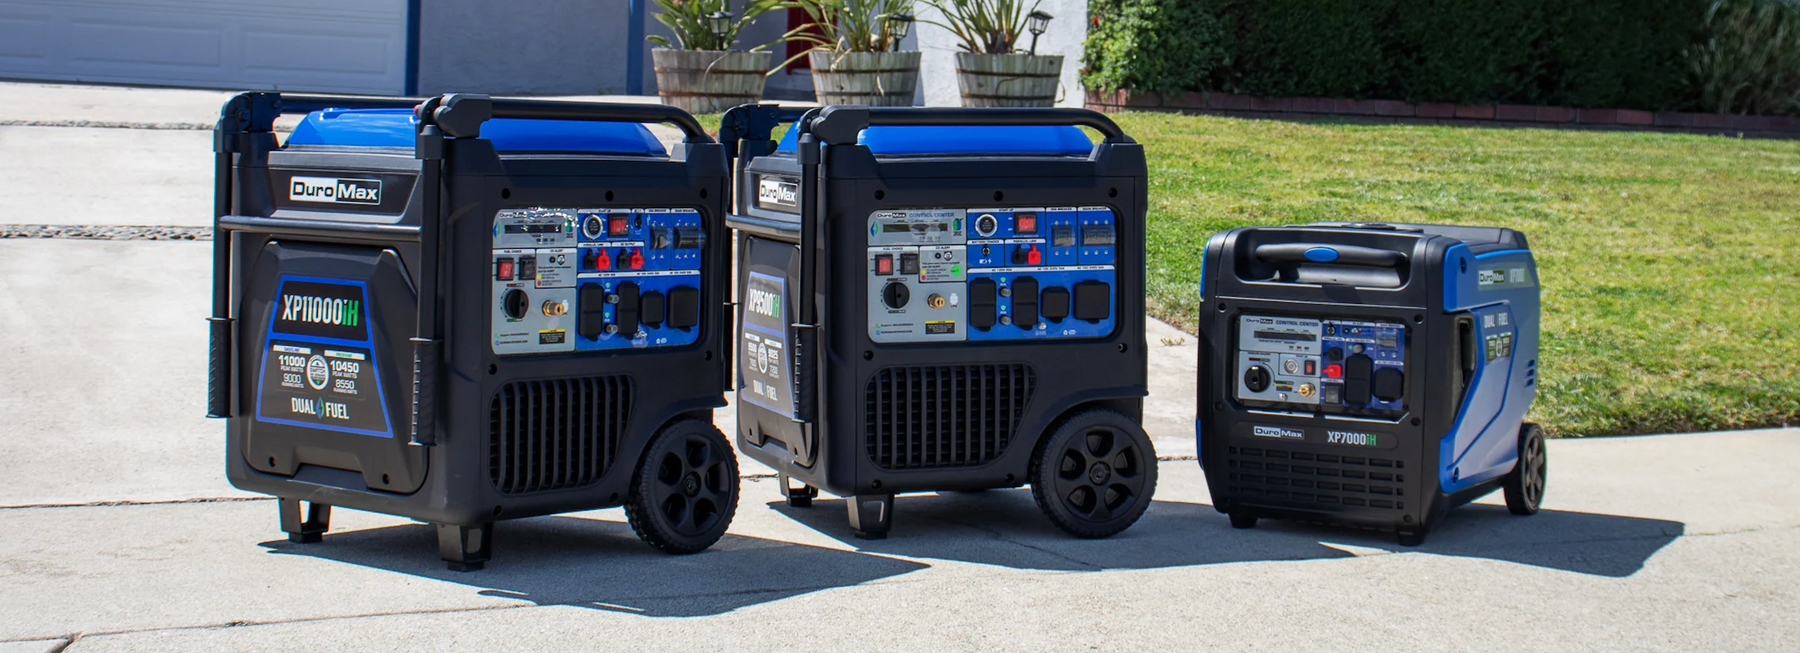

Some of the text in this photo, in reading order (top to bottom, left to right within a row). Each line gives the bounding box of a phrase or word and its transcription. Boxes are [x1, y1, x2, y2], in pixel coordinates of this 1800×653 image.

[761, 184, 796, 203] DuroMax
[282, 294, 359, 327] XP11000iH
[278, 355, 306, 368] 11000
[330, 360, 360, 374] 10450
[283, 373, 302, 384] 9000
[335, 379, 355, 389] 8550
[291, 397, 350, 419] DUAL FUEL
[1255, 427, 1377, 446] DuroMax XP7000iH
